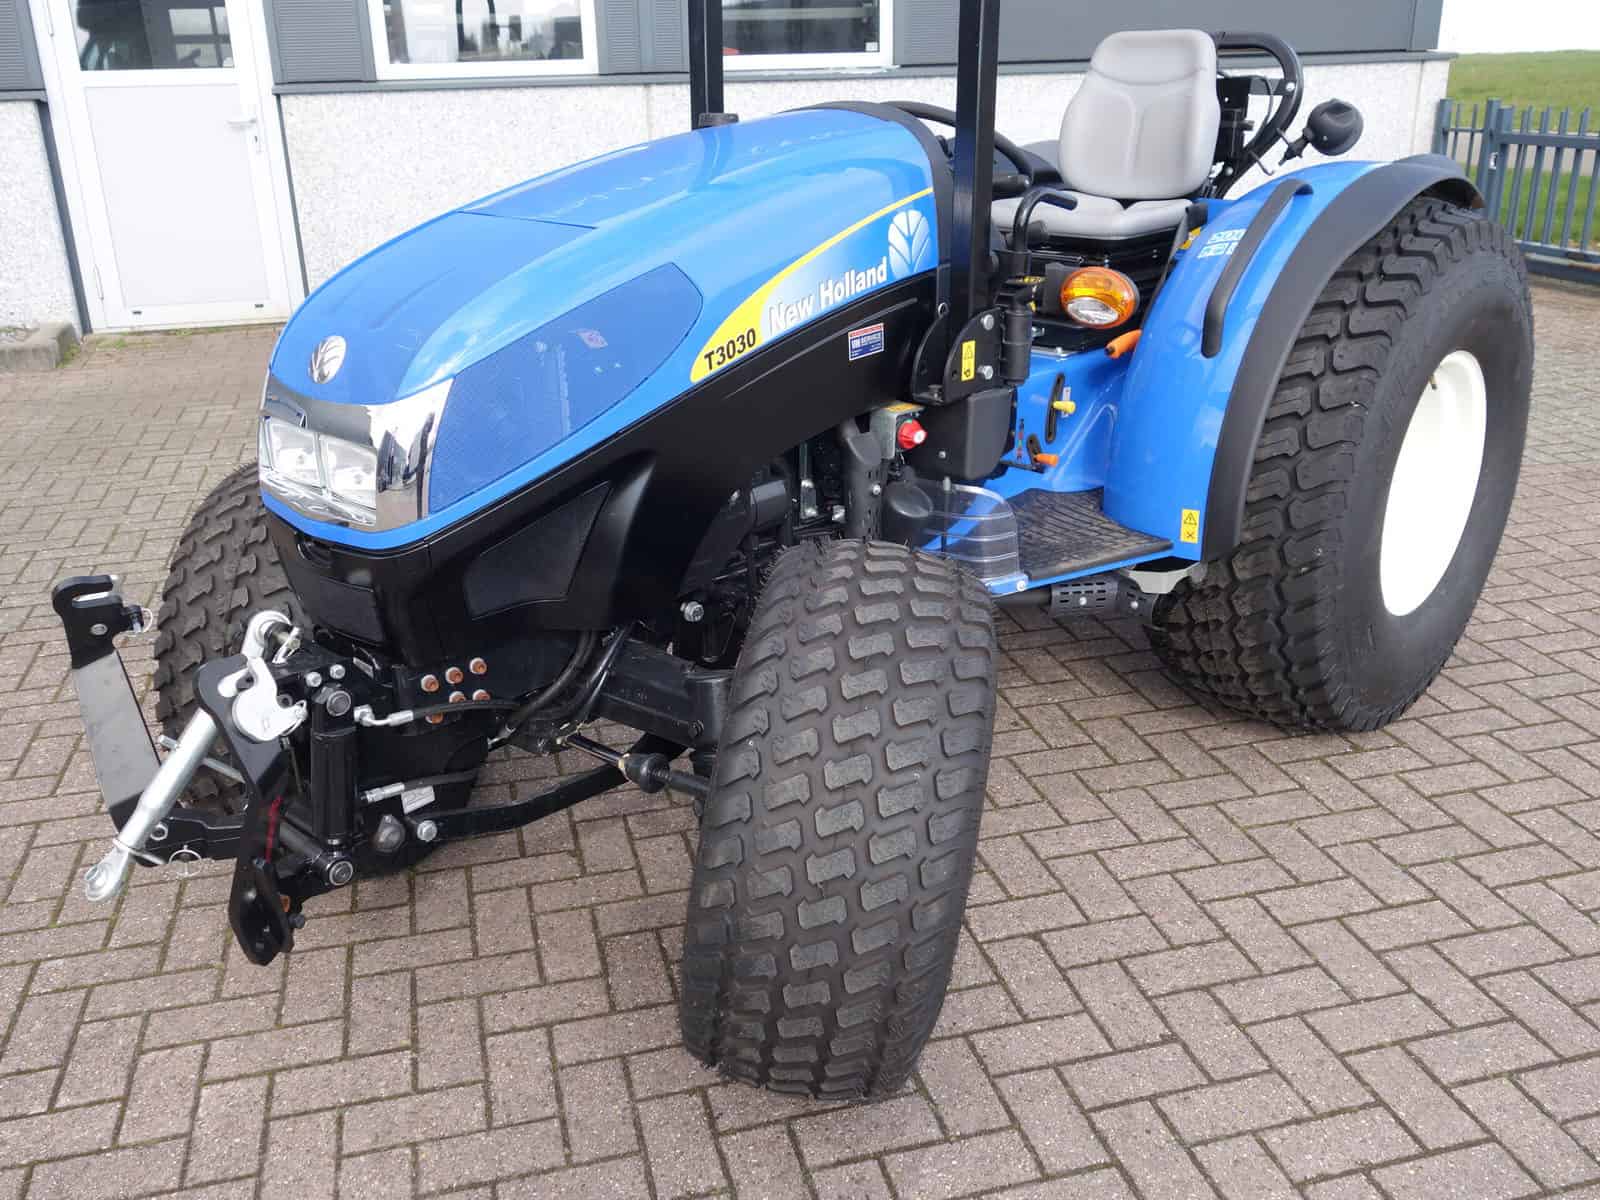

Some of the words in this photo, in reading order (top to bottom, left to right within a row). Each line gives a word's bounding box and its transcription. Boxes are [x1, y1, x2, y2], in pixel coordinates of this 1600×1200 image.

[768, 294, 815, 336] New
[819, 256, 887, 311] Holland
[704, 328, 756, 371] T3030
